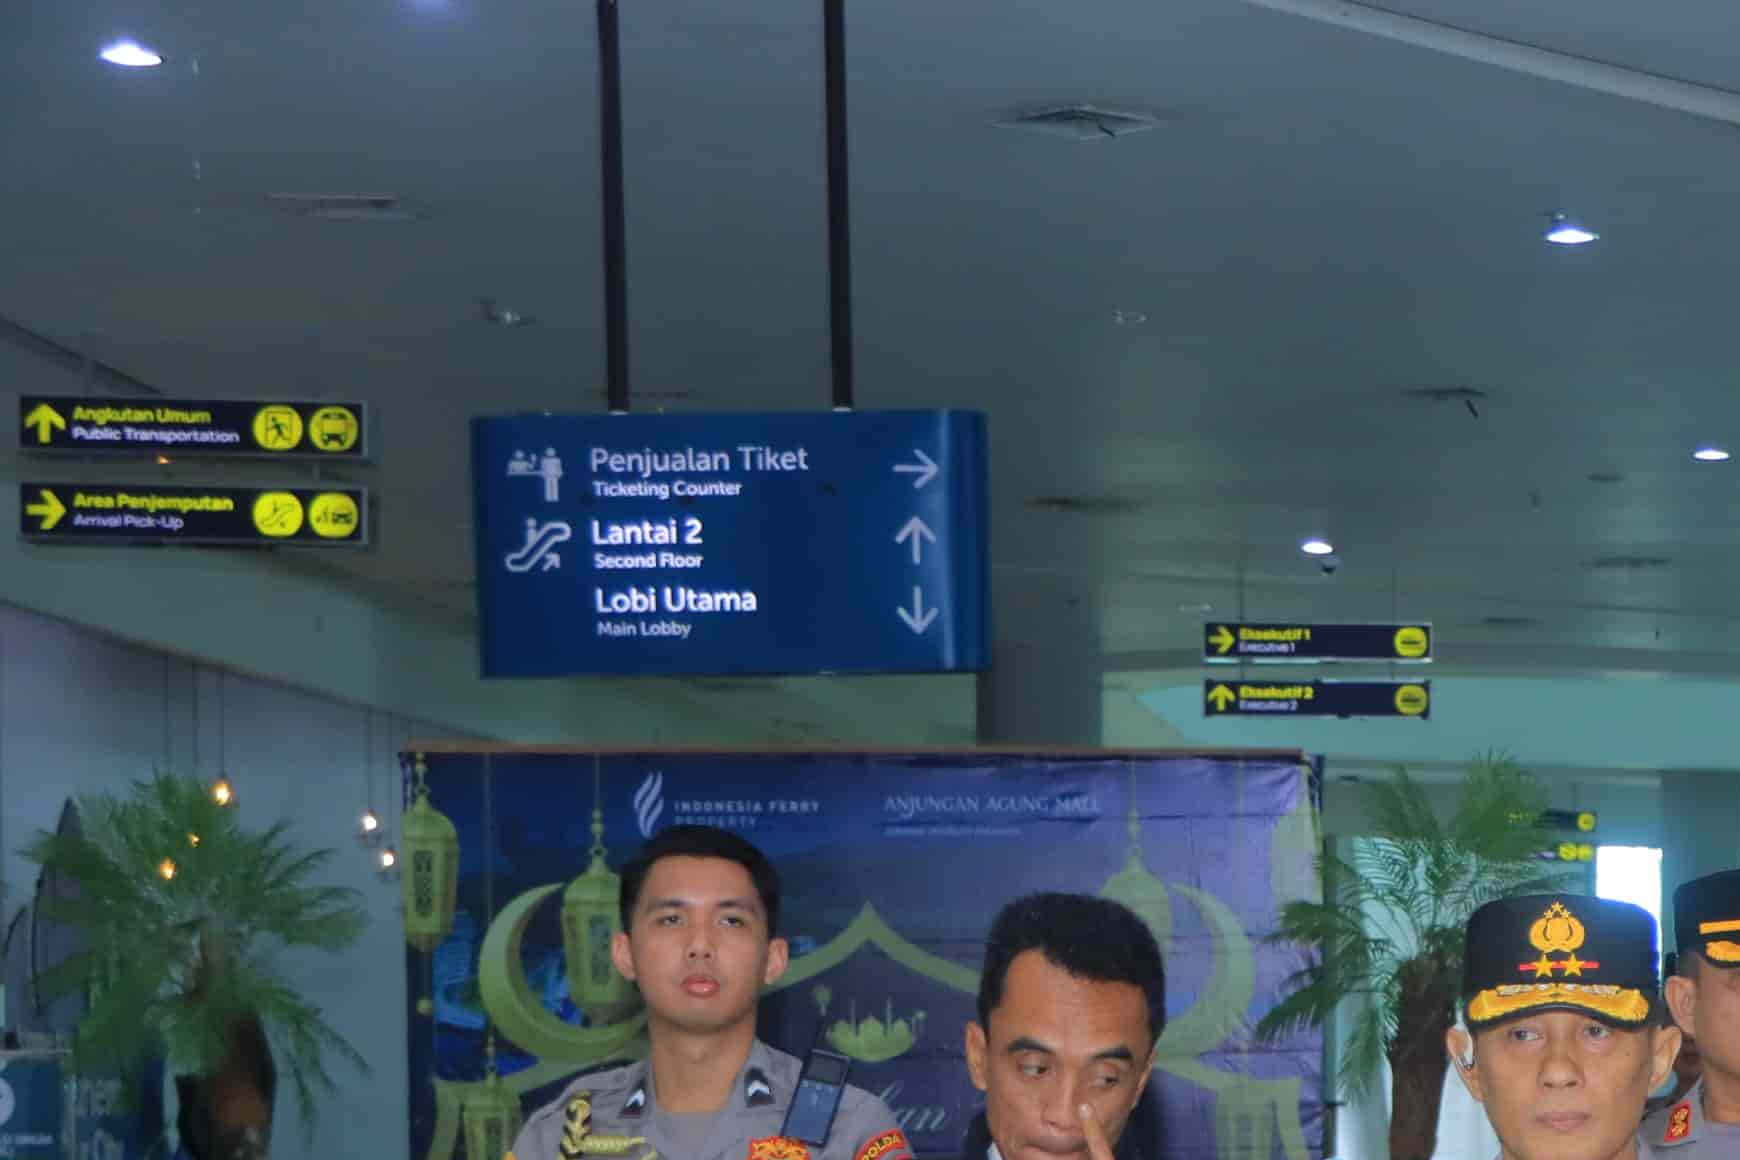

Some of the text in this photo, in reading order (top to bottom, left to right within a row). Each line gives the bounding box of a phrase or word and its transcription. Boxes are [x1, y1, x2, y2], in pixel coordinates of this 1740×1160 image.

[73, 406, 211, 424] Angkutan Umum
[72, 426, 240, 444] Public Transportation
[591, 446, 809, 478] Penjualan Tiket
[592, 480, 743, 500] Ticketing Counter
[74, 492, 234, 514] Area Penjemputan
[73, 514, 185, 530] Arrival Pick-Up
[592, 517, 703, 545] Lantai 2
[594, 552, 703, 568] Second Floor
[595, 586, 758, 613] Lobi Utama
[596, 621, 692, 638] Main Lobby
